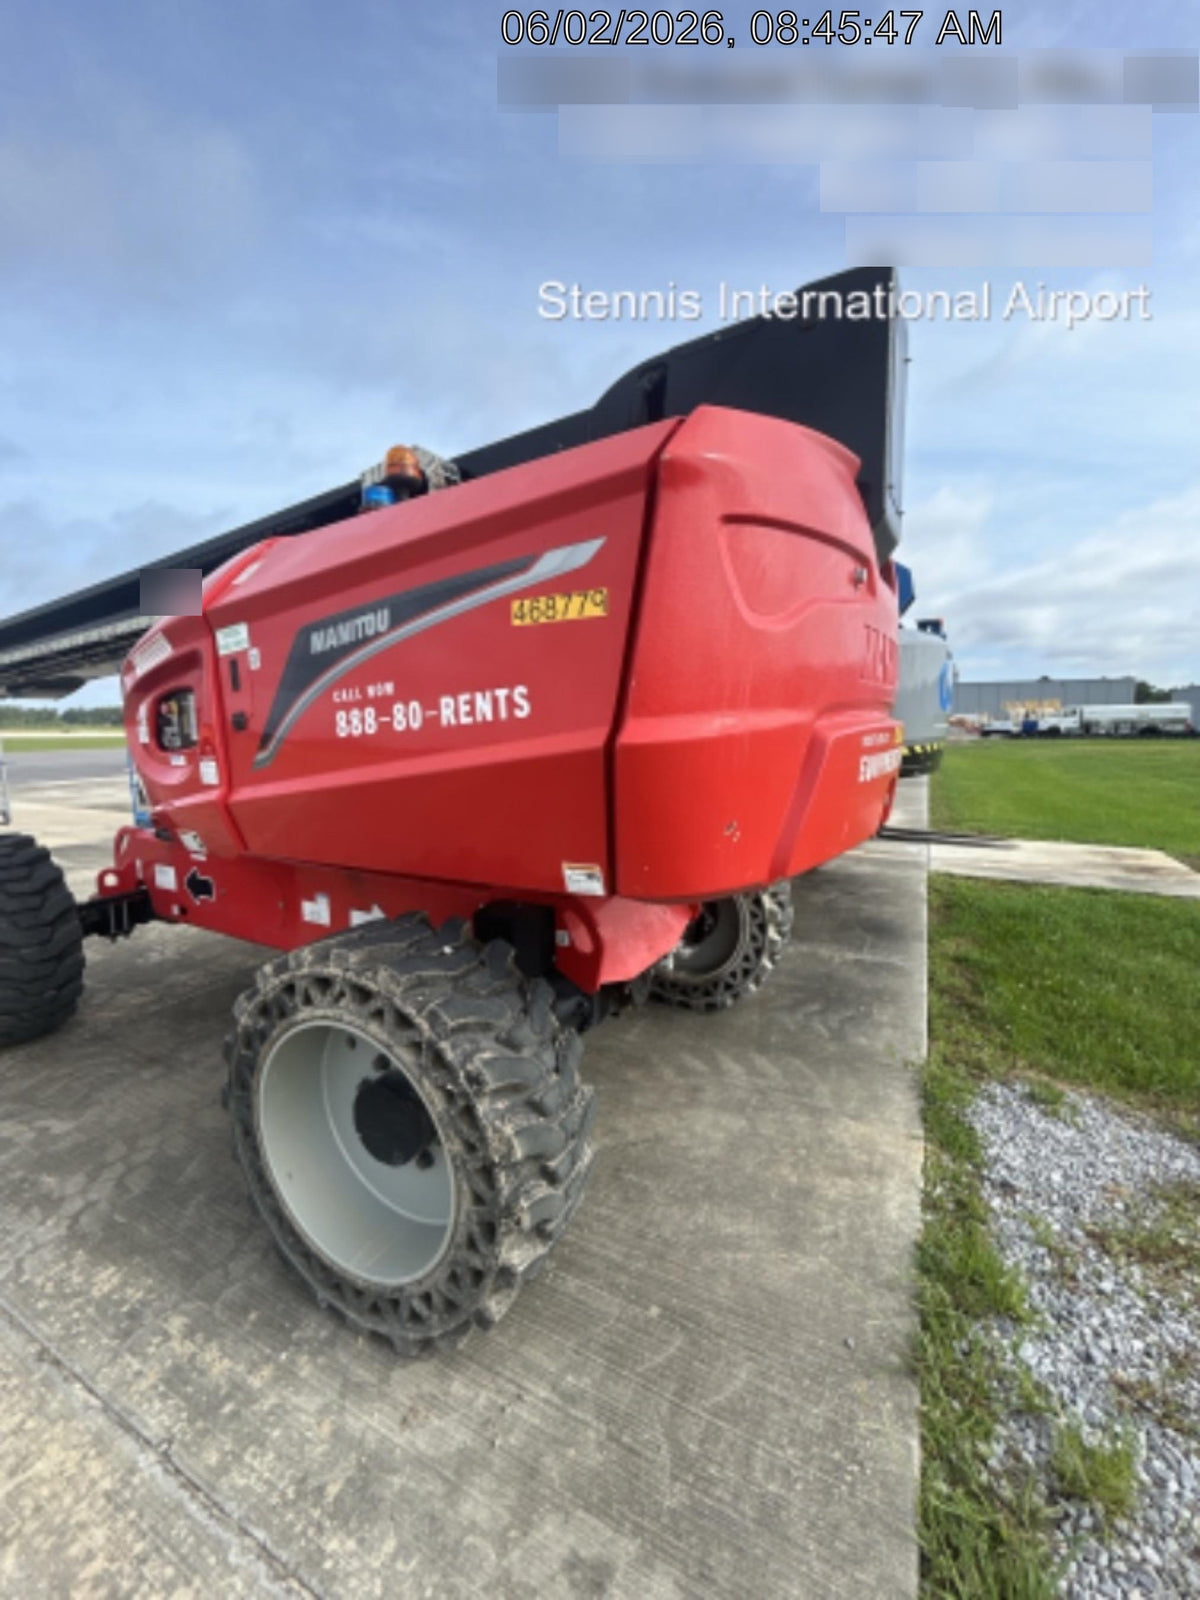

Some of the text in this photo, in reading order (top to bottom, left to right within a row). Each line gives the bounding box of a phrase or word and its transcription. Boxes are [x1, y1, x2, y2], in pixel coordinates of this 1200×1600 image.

[310, 608, 390, 655] MANITOU
[332, 686, 362, 703] CALL
[334, 685, 531, 738] 888-80-RENTS
